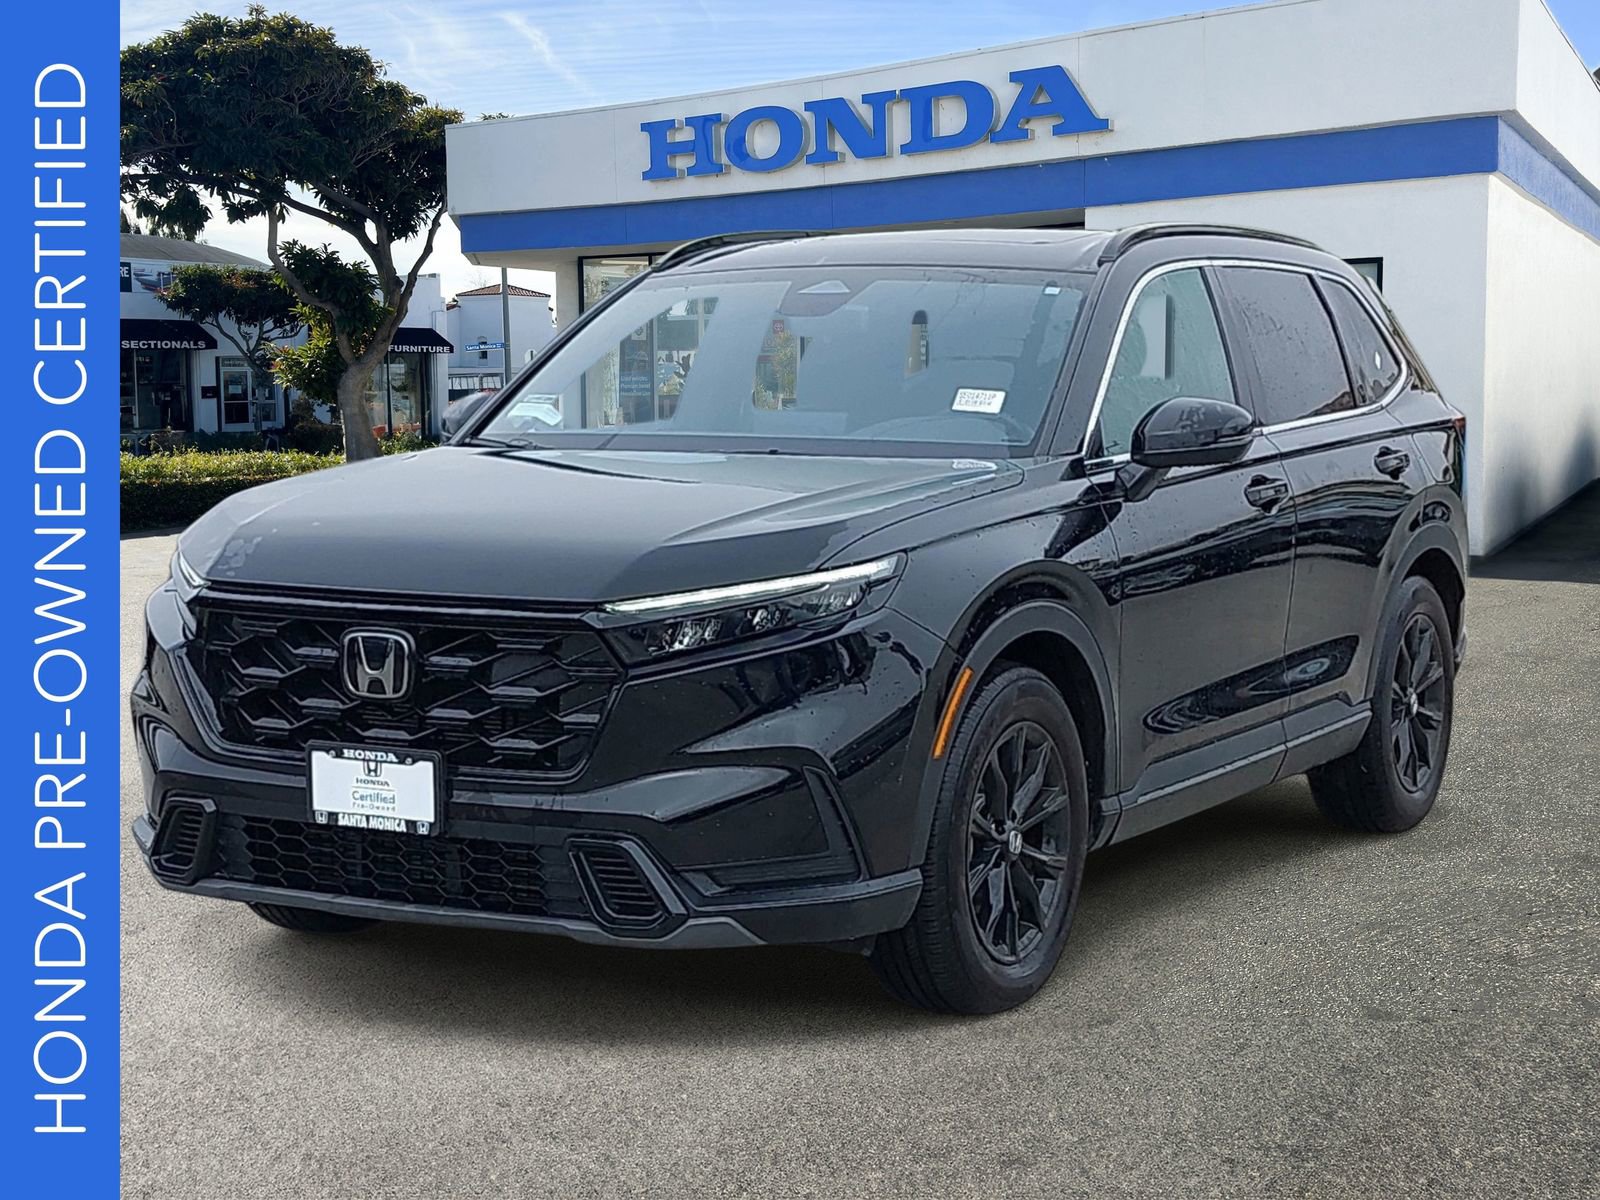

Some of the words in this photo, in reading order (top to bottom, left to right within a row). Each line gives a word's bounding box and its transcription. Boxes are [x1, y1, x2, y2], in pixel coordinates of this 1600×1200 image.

[640, 65, 1112, 181] HONDA
[121, 340, 206, 349] SECTIONALS
[388, 344, 451, 353] FURNITURE
[342, 749, 399, 763] HONDA
[355, 777, 390, 787] HONDA
[352, 790, 396, 805] Certified
[337, 813, 368, 829] SANTA
[369, 816, 407, 833] MONICA
